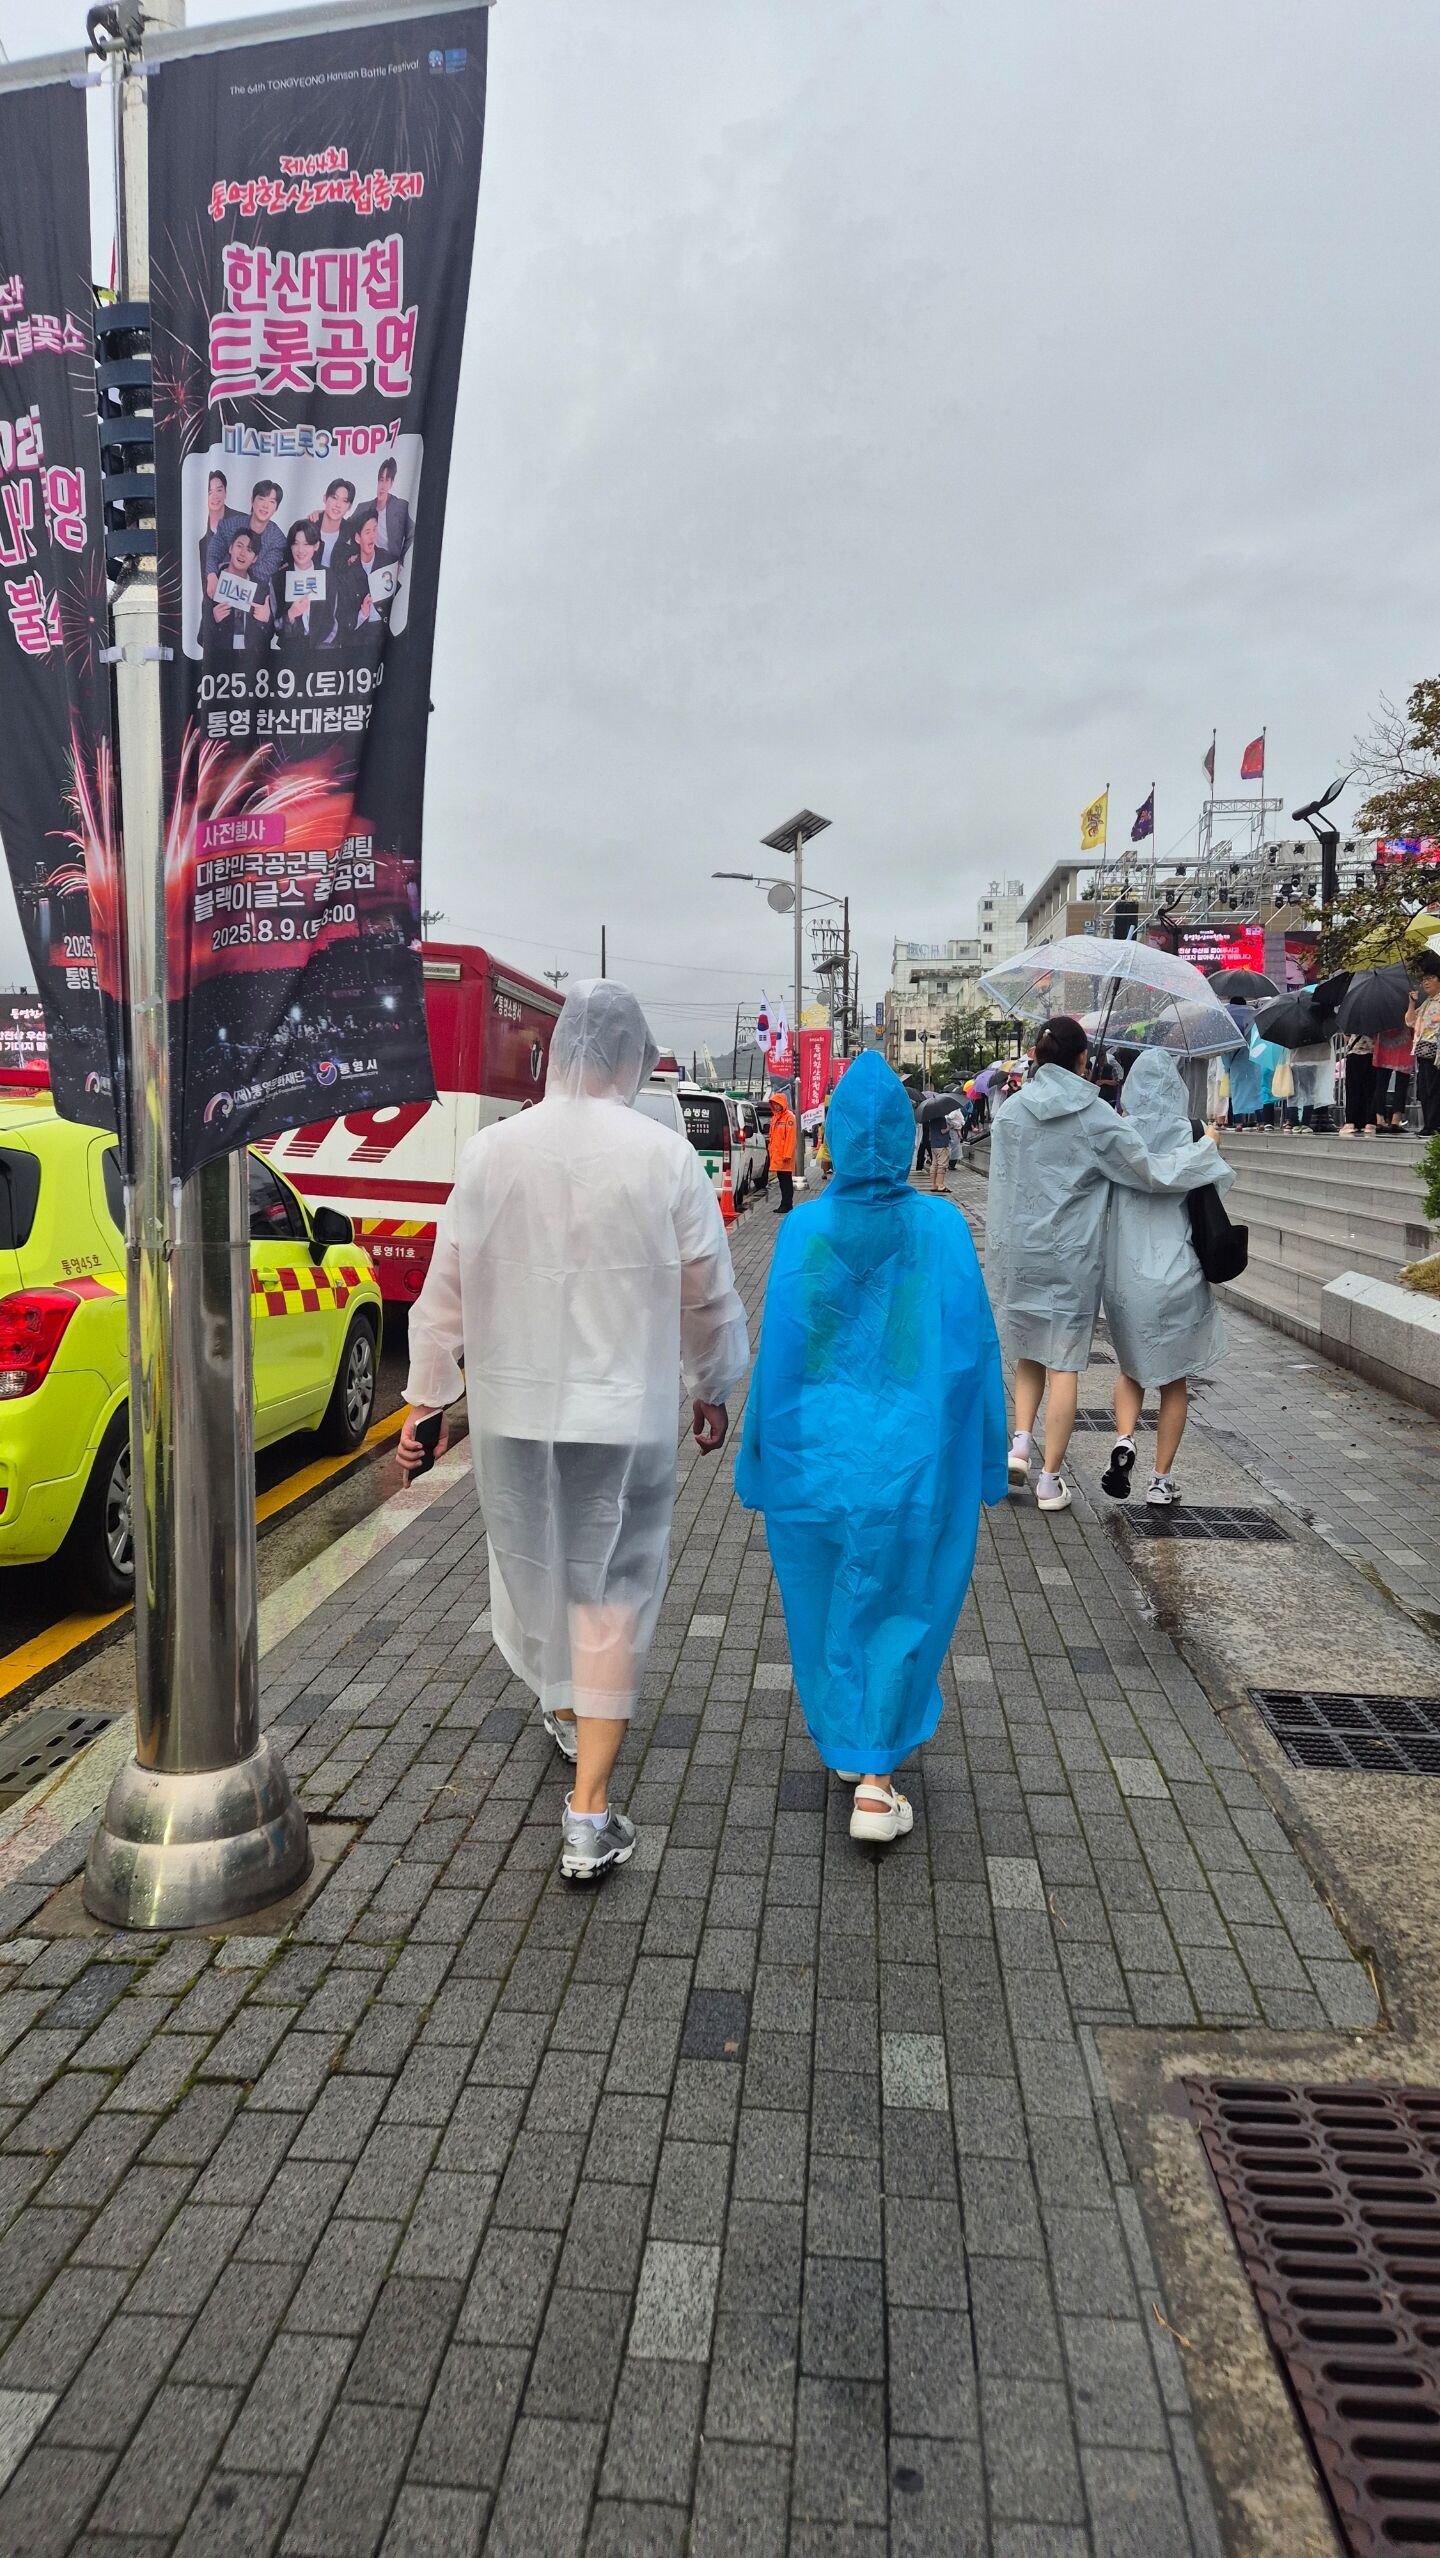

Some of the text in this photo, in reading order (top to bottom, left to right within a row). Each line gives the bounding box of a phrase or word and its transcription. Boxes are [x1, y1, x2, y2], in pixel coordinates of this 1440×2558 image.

[230, 86, 246, 97] The
[247, 83, 266, 95] 64th
[267, 74, 325, 91] TONGYEONG
[326, 68, 360, 84] Hansan
[360, 66, 387, 79] Battle
[387, 58, 420, 75] Festival
[280, 146, 348, 175] 제64회
[208, 169, 425, 222] 통영한산대첩축제
[222, 233, 403, 315] 한산대첩
[208, 304, 419, 410] 트롯공연
[222, 422, 332, 459] 미스터트롯3
[219, 578, 252, 602] 미스터
[293, 577, 318, 596] 트롯
[381, 571, 395, 592] 3
[207, 709, 250, 738] 통영
[203, 819, 266, 848] 사전행사
[194, 879, 305, 923] 블랙이글스
[340, 1058, 378, 1075] 통영시
[61, 1254, 103, 1275] 통영45호
[372, 1244, 416, 1259] 통영11호
